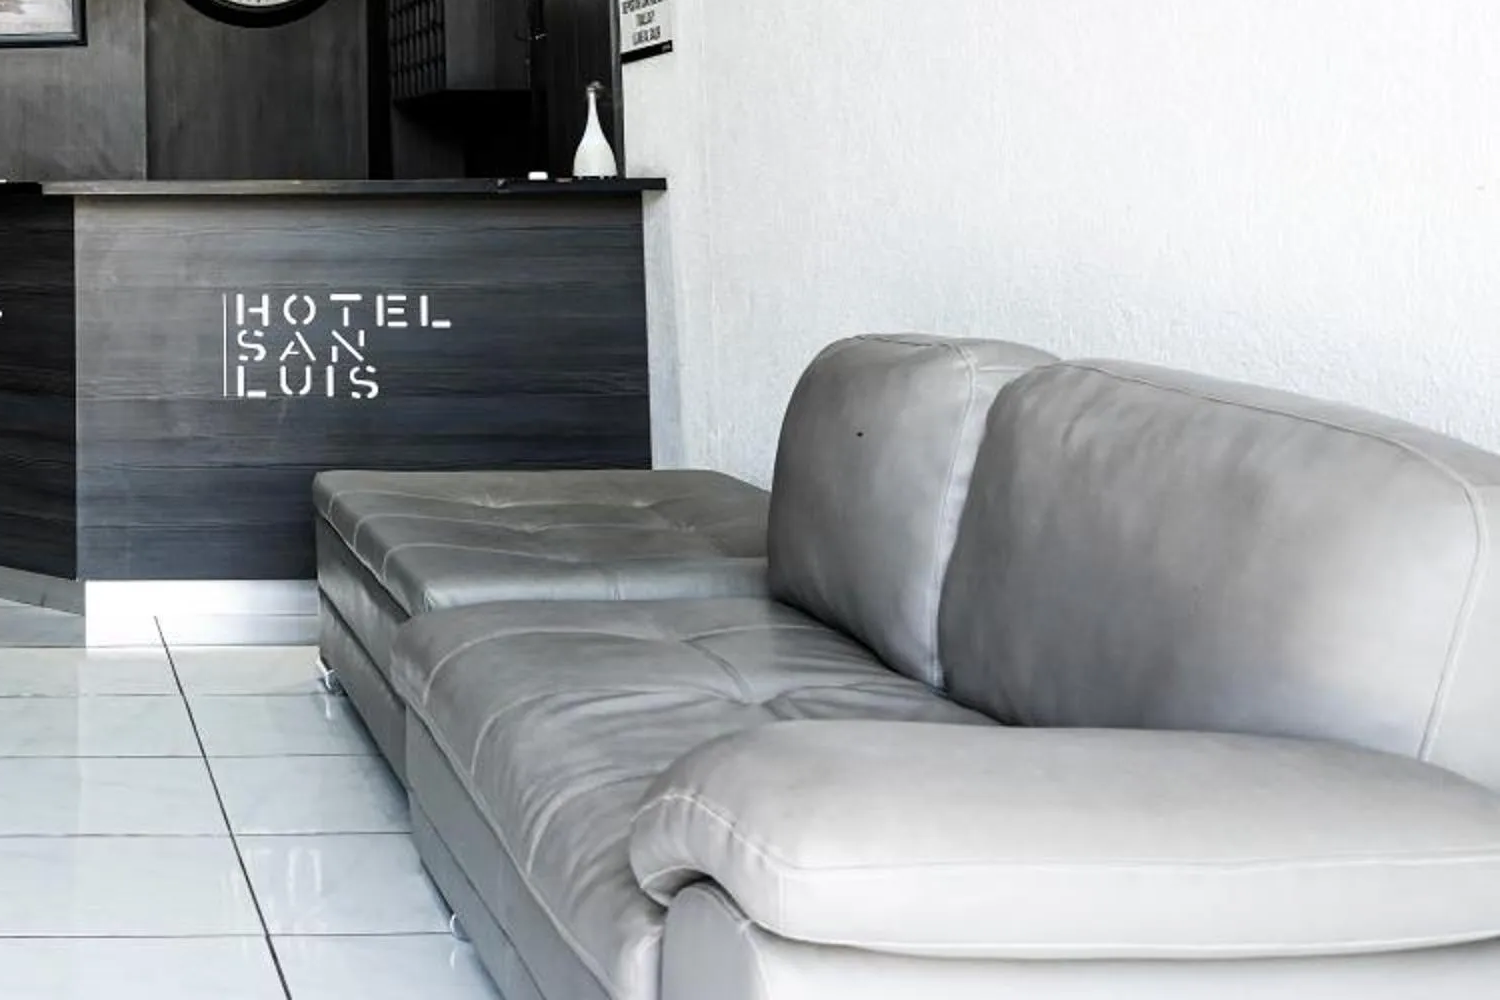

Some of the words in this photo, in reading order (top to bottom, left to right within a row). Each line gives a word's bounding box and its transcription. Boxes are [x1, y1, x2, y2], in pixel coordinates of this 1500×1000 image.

[236, 293, 452, 328] HOTEL
[237, 329, 365, 363] SAN
[237, 365, 380, 399] LUIS
